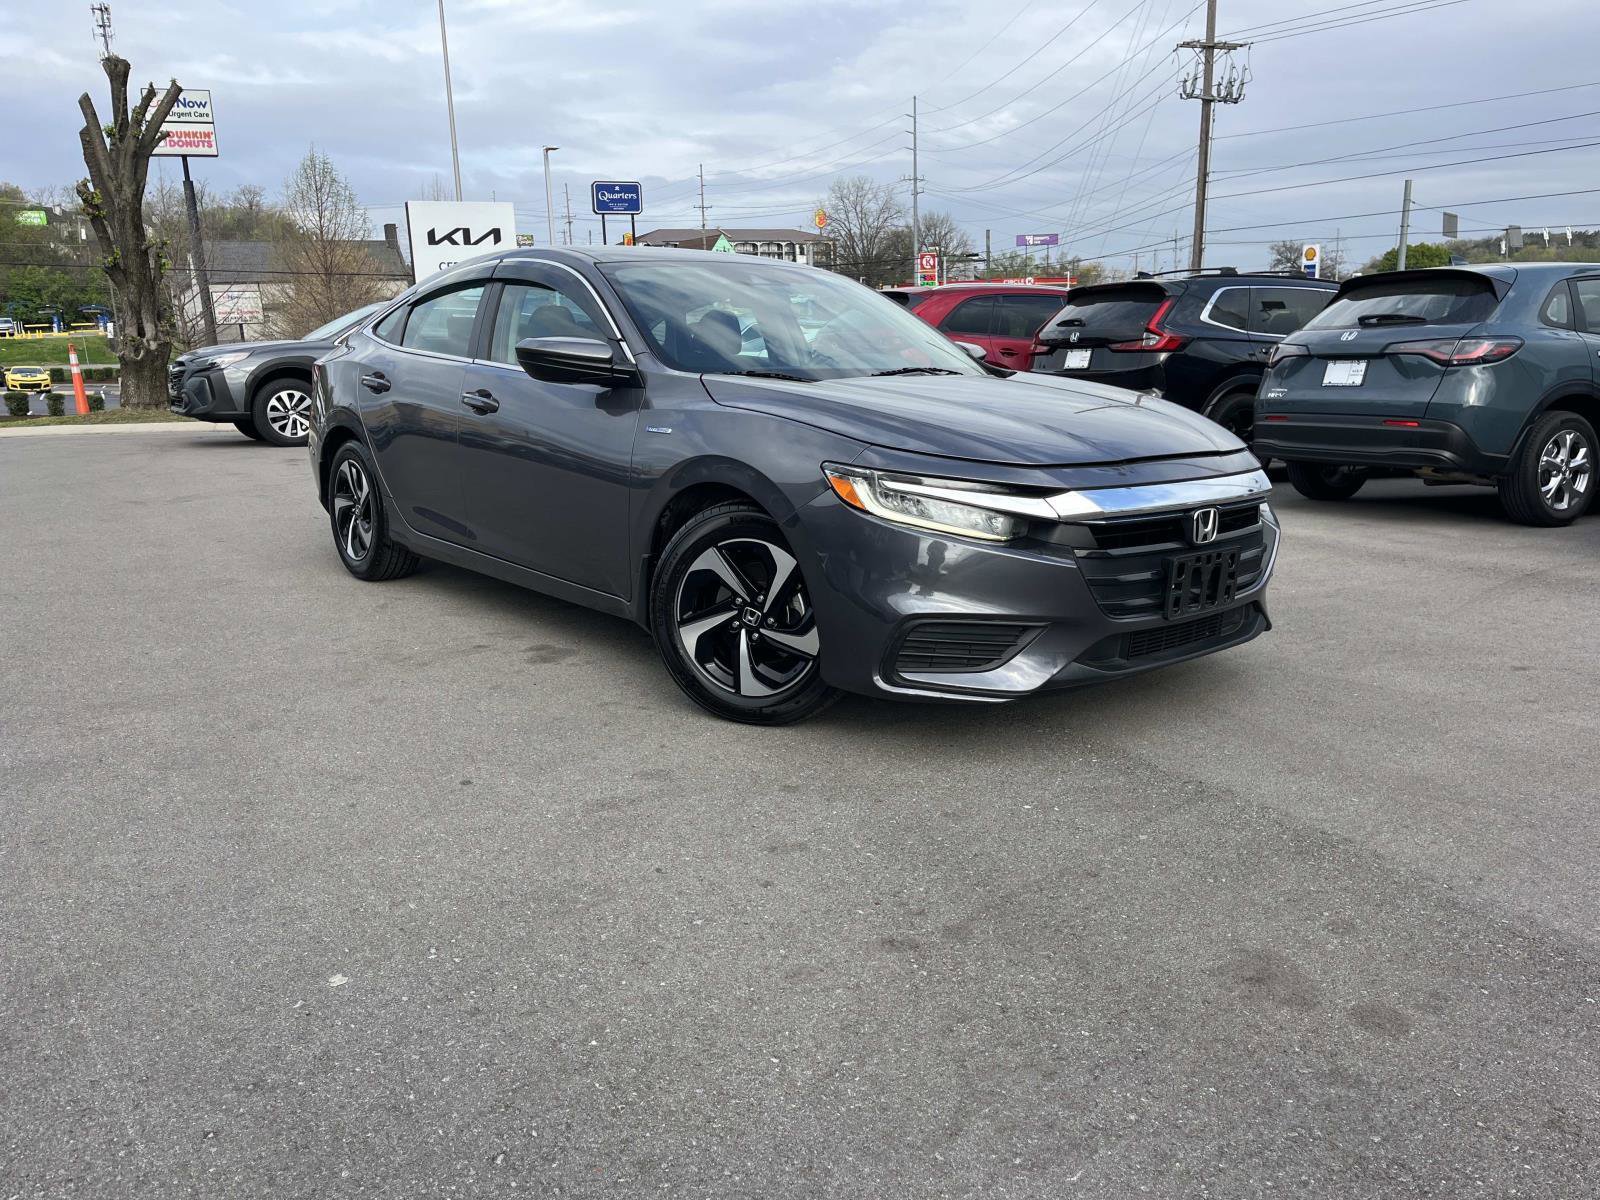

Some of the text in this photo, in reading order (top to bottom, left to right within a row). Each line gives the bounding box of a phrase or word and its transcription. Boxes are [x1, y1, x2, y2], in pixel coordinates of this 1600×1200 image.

[169, 140, 213, 148] DONUTS
[598, 190, 637, 202] Quarters
[427, 227, 502, 246] KIA
